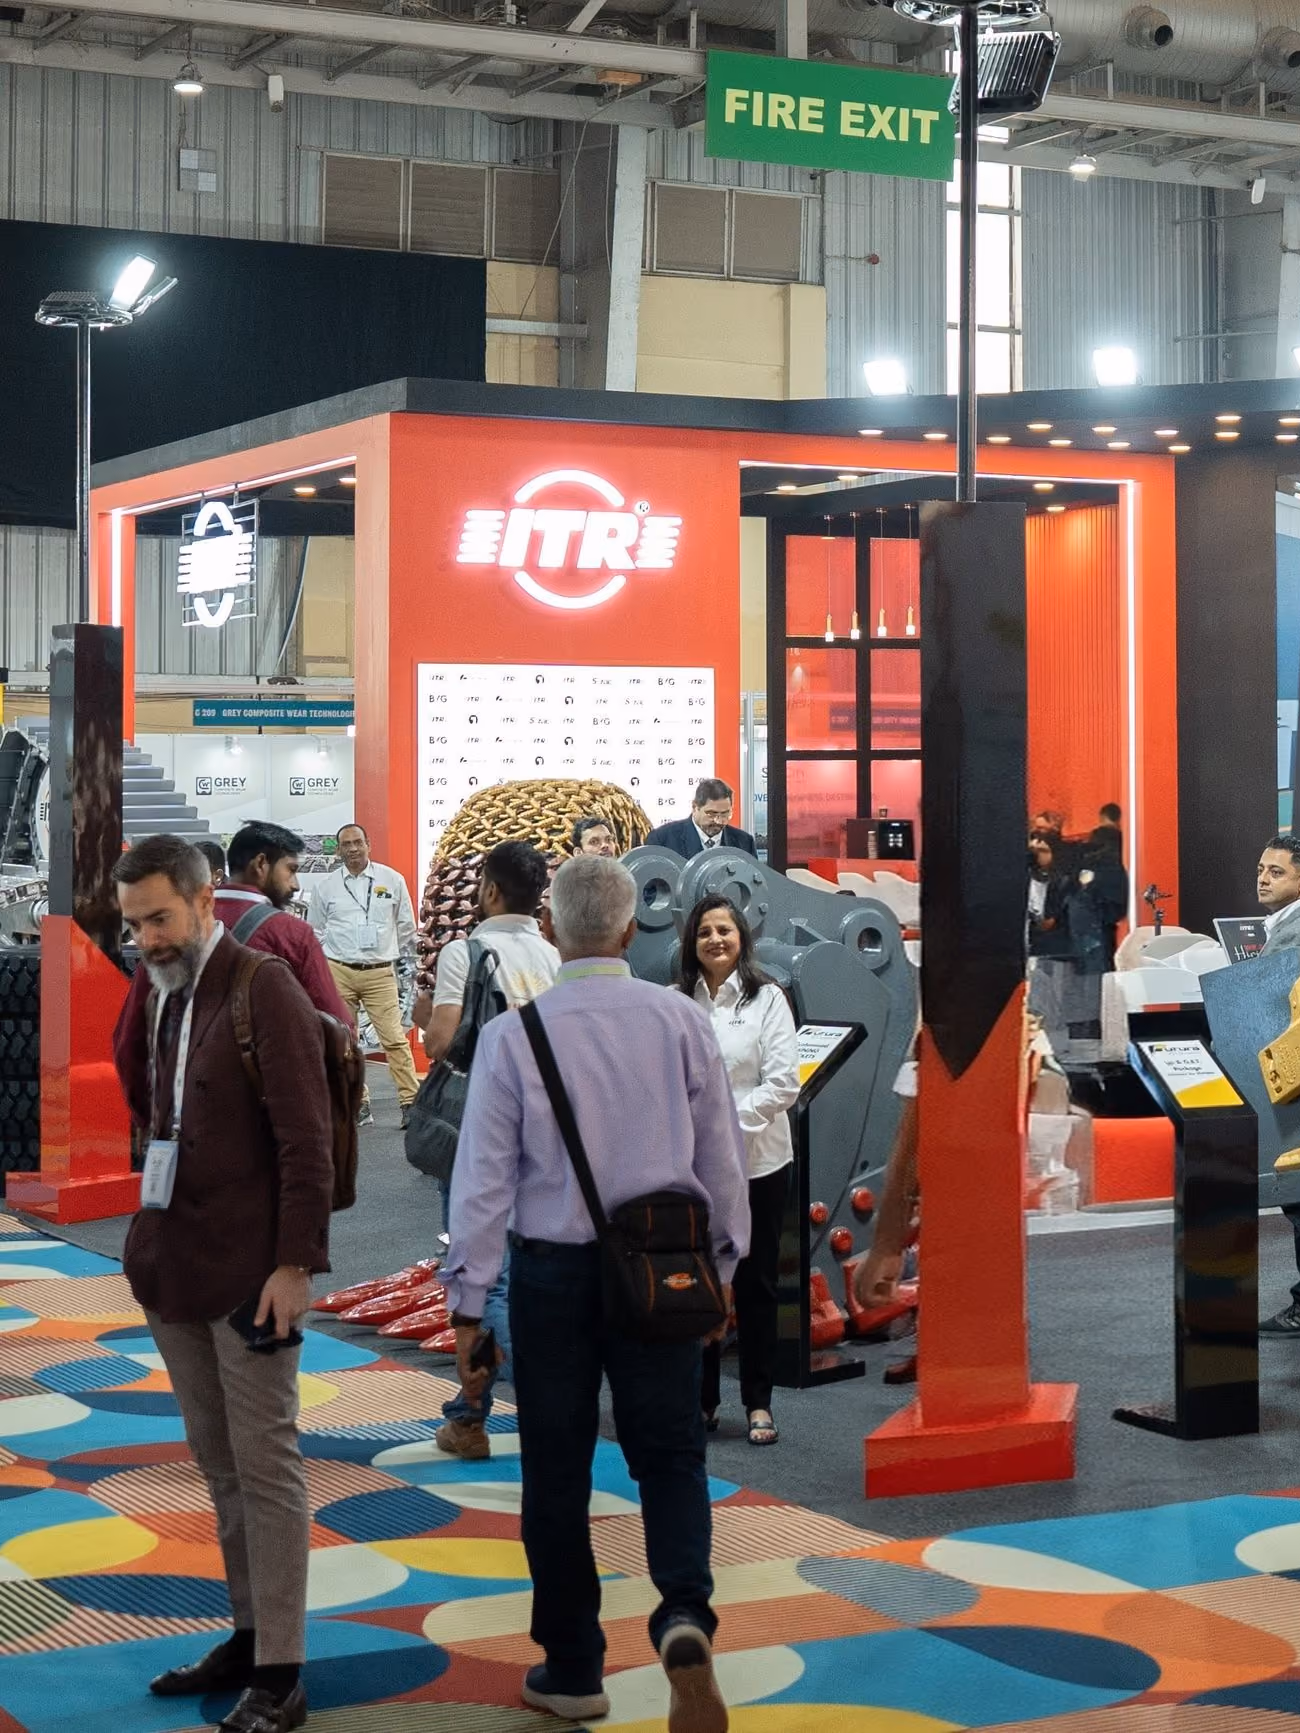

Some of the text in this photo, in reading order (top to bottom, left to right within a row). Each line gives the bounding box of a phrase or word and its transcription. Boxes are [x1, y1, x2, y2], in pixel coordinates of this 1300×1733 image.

[724, 88, 939, 144] FIRE EXIT
[498, 508, 639, 570] ITR
[194, 708, 200, 717] C
[201, 708, 216, 717] 209
[222, 708, 241, 717] GREY
[243, 709, 284, 718] COMPOSITE
[286, 709, 307, 718] WEAR
[214, 777, 247, 787] GREY
[307, 777, 339, 787] GREY
